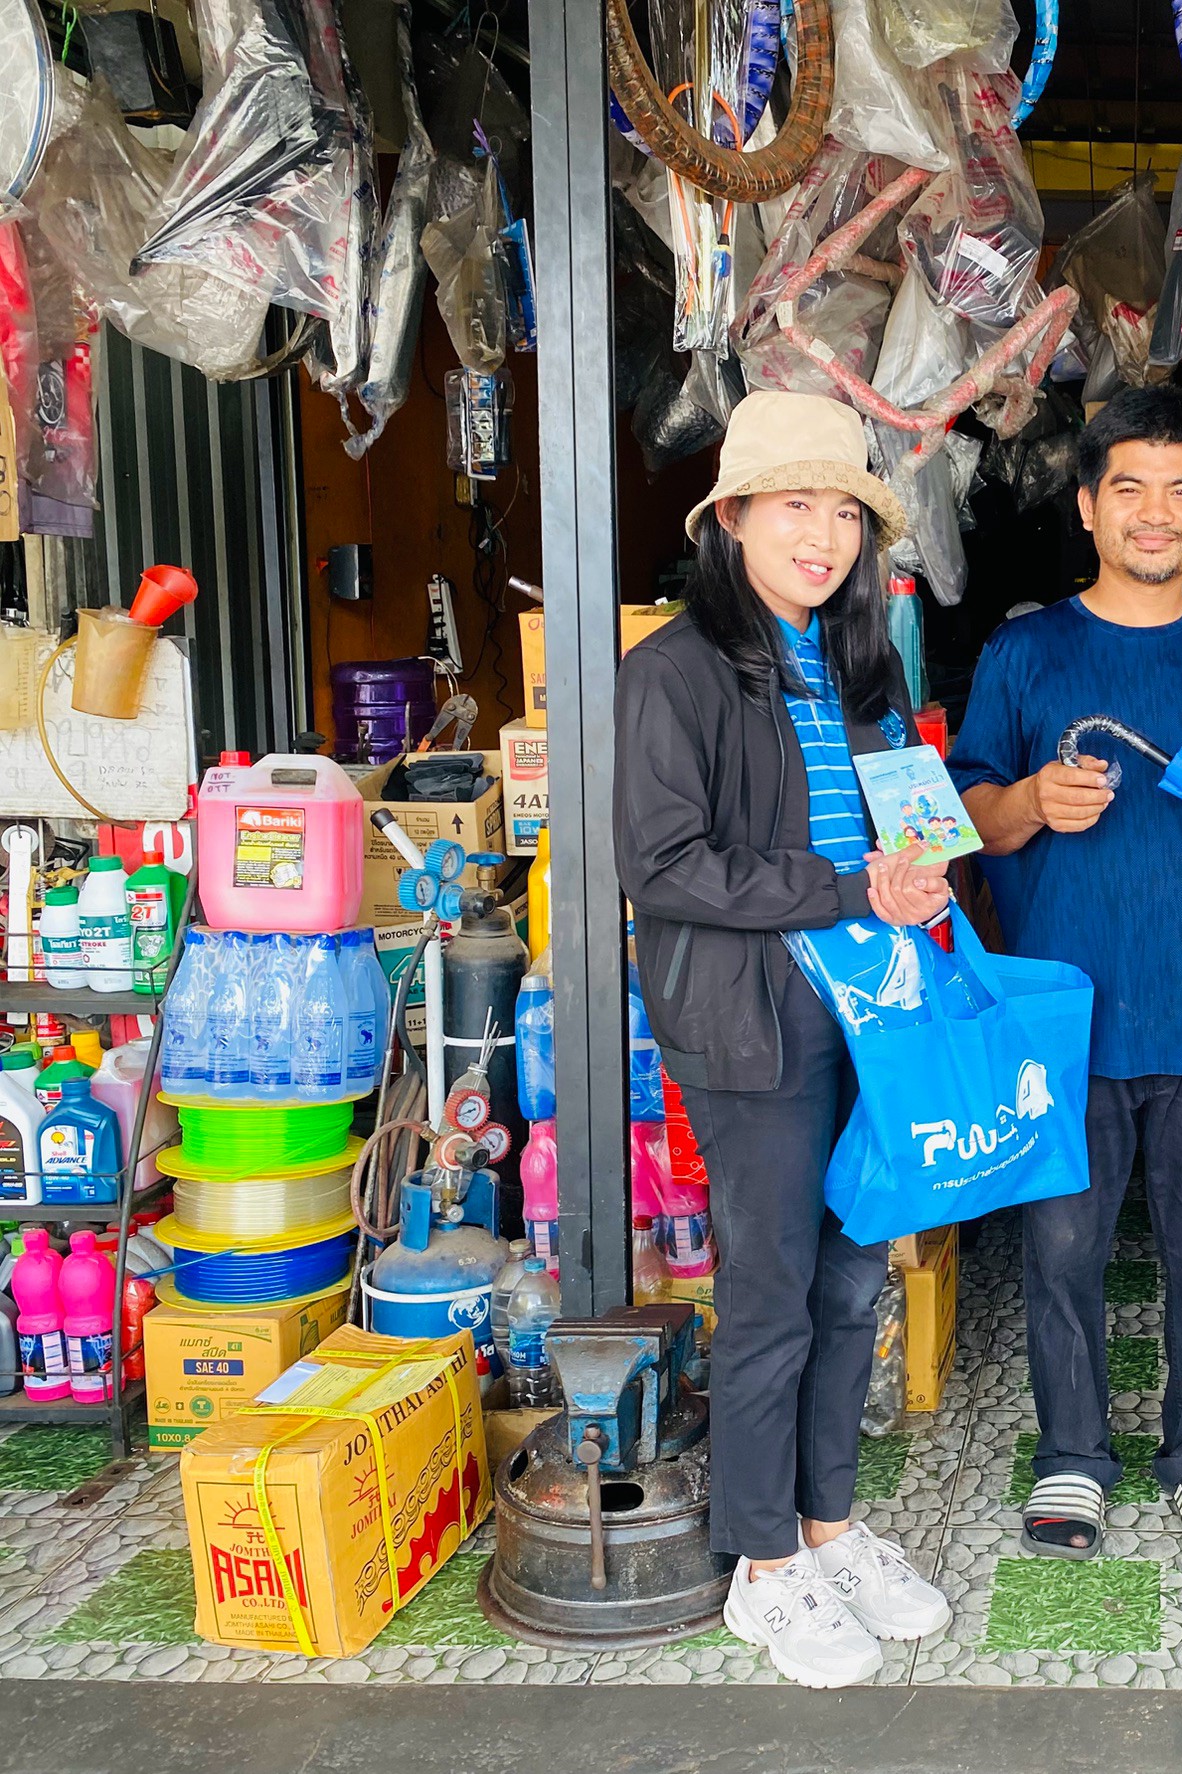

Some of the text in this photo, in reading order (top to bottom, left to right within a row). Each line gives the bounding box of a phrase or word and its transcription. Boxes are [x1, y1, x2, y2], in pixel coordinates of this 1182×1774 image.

[262, 815, 302, 828] Bariki
[131, 906, 156, 921] 2T
[45, 1156, 87, 1164] ADVANCE
[179, 1336, 213, 1348] แมกซ์
[201, 1346, 227, 1358] สปีด
[195, 1361, 229, 1374] SAE 40
